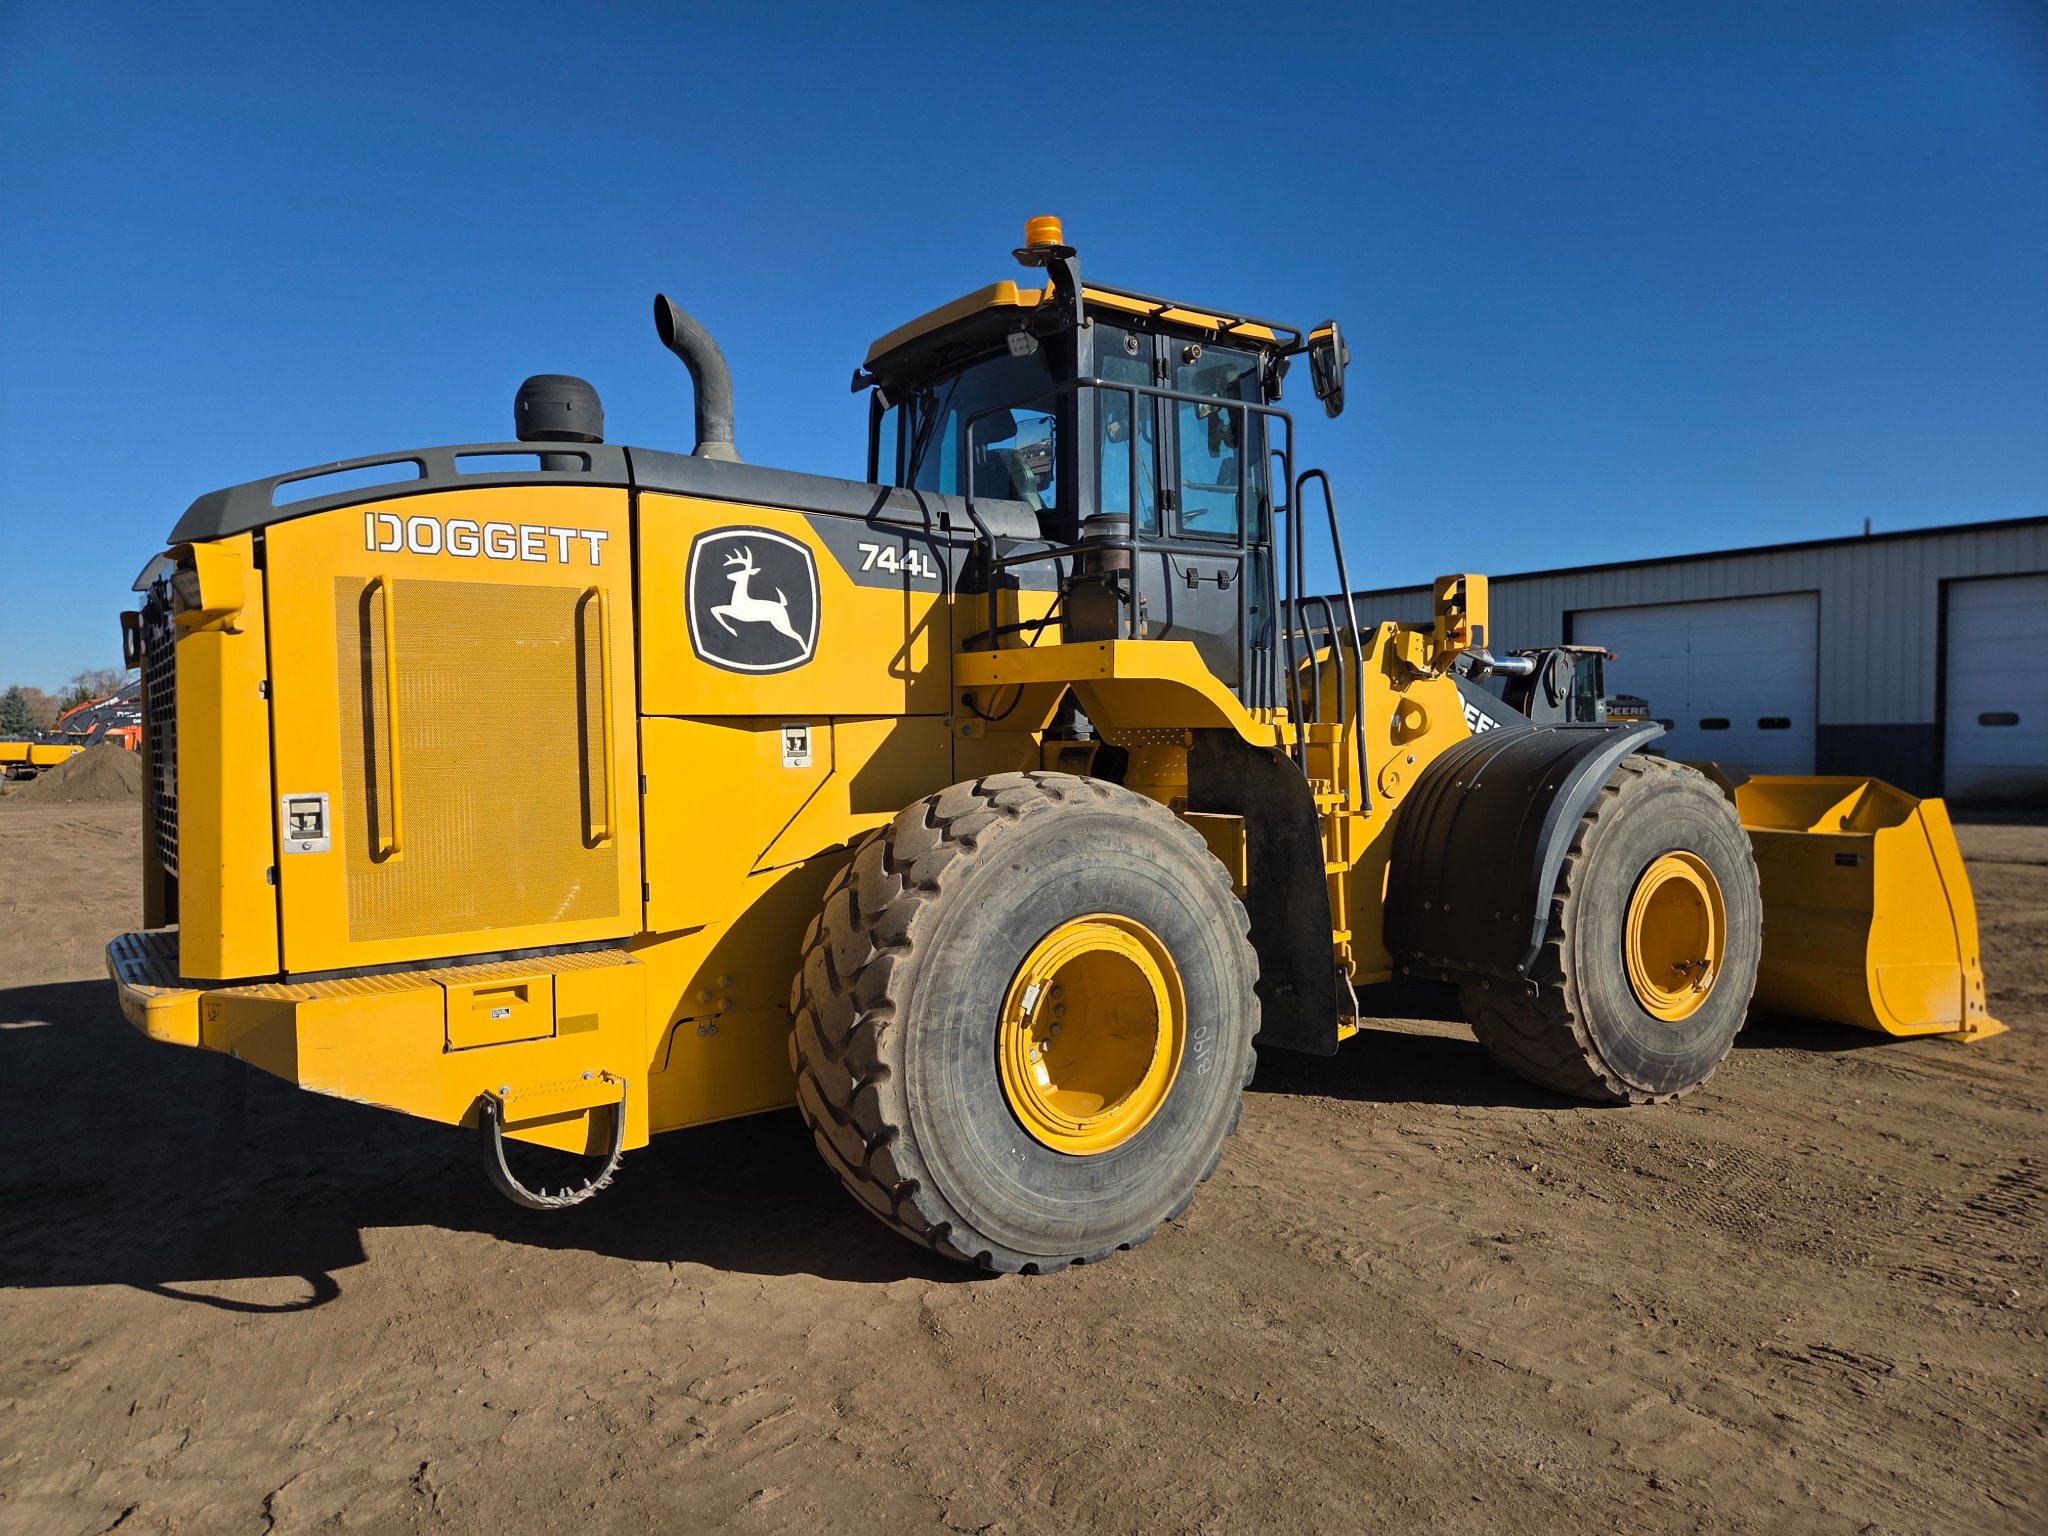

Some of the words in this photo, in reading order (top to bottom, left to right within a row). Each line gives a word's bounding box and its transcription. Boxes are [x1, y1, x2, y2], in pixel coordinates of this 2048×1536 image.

[364, 512, 609, 566] DOGGETT
[857, 541, 938, 579] 744L
[1457, 690, 1502, 734] EE
[1605, 706, 1648, 715] DEERE
[1194, 1026, 1211, 1076] B190
